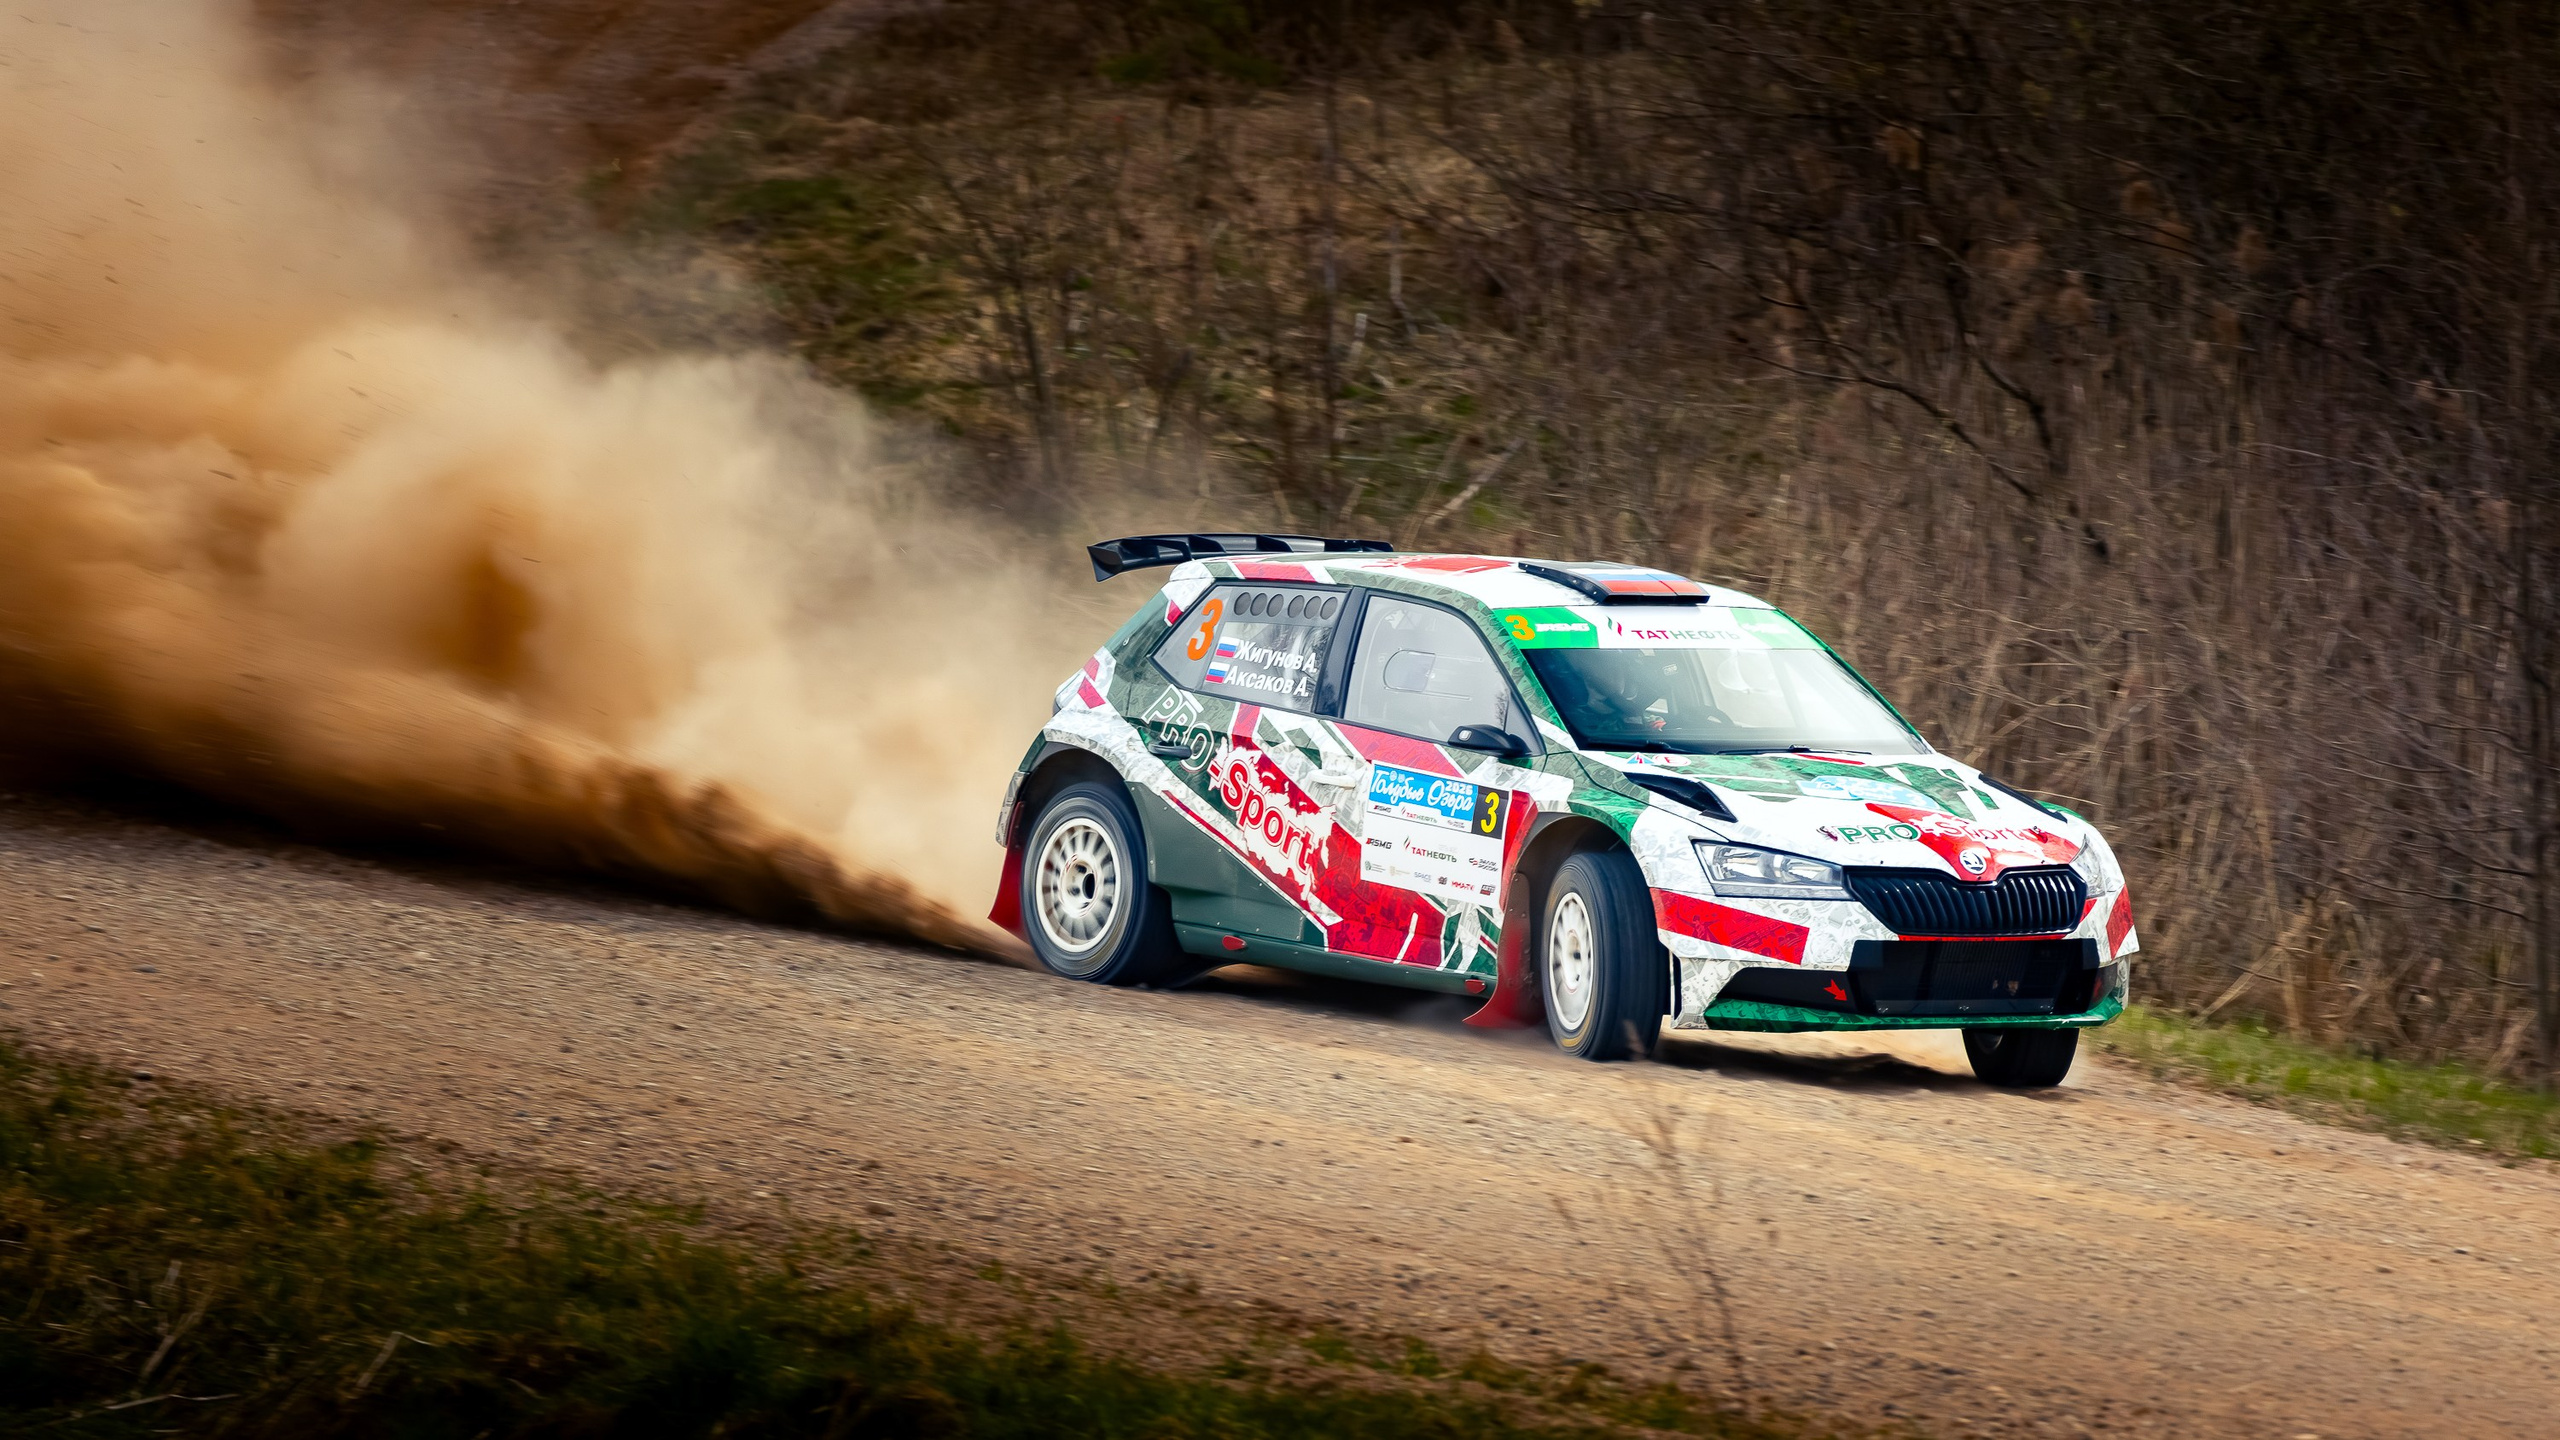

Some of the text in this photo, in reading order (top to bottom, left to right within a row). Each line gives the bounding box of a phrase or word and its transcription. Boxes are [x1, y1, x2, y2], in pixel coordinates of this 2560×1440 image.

[1187, 598, 1224, 661] 3
[1505, 614, 1536, 641] 3
[1631, 629, 1740, 640] ТАТНЕФТЬ
[1235, 640, 1319, 673] Жигунов А.
[1223, 665, 1310, 697] Аксаков А.
[1480, 791, 1500, 833] 3
[1411, 846, 1458, 863] ТАТНЕФТЬ
